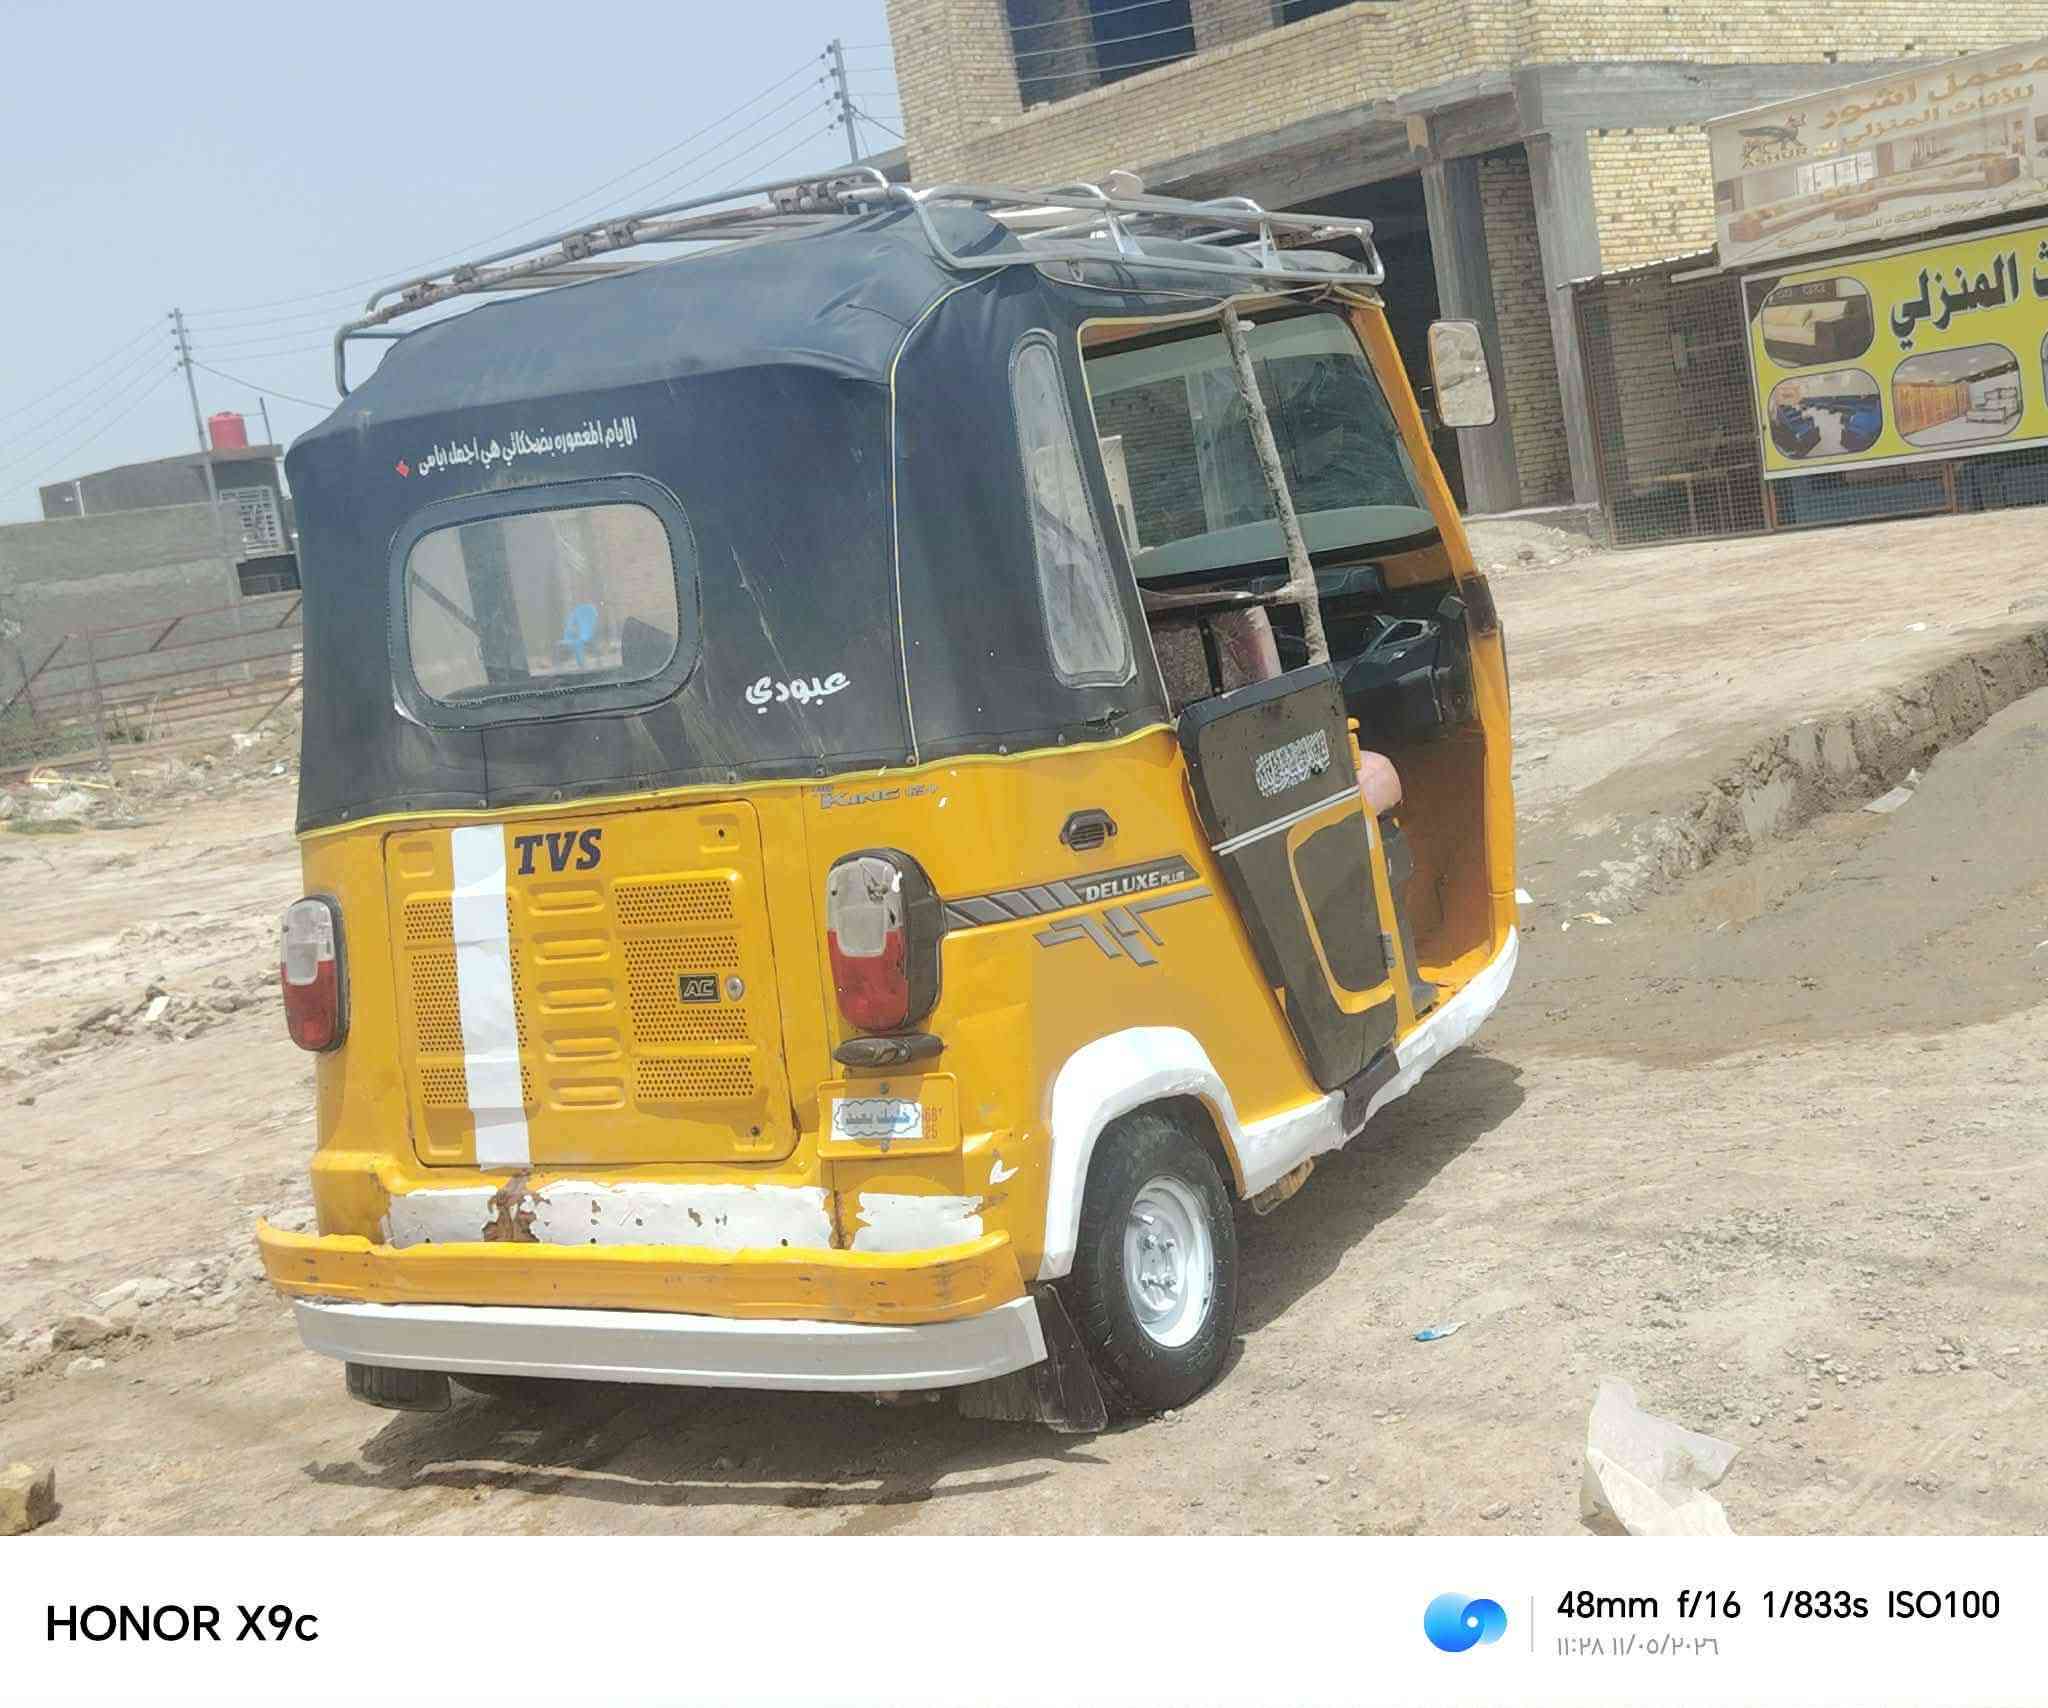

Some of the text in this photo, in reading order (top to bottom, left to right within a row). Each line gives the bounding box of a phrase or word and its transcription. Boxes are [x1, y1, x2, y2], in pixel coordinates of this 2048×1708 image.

[1891, 251, 2019, 350] المنزلي
[745, 672, 851, 714] عبودي
[514, 828, 602, 875] TVS
[1085, 871, 1160, 902] DELUXE
[683, 979, 715, 998] AC
